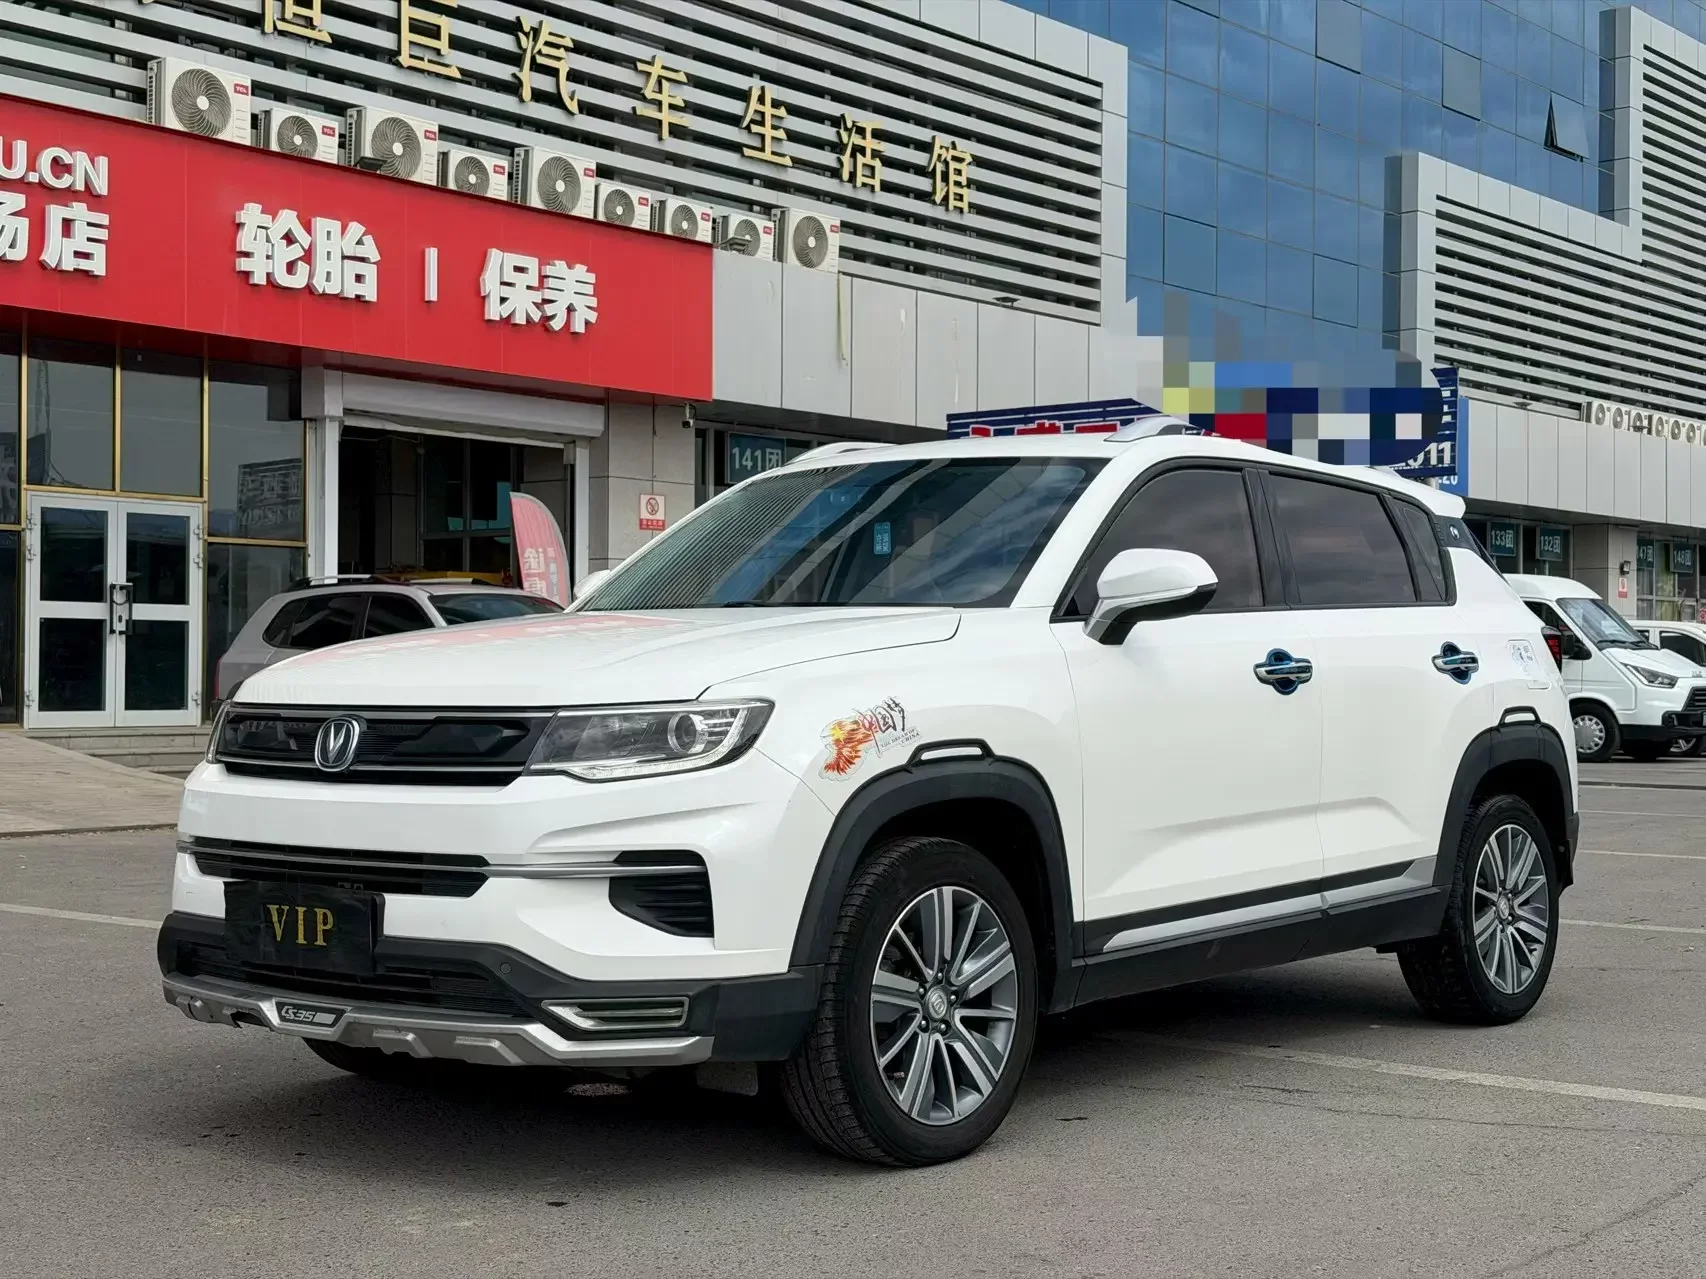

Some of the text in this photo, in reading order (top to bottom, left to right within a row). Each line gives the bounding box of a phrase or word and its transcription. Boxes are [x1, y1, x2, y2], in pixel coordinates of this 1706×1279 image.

[234, 84, 249, 95] TCL
[322, 126, 335, 137] TCL
[424, 130, 437, 140] TCL
[235, 201, 598, 333] 轮胎 保养
[266, 904, 334, 946] VIP
[280, 1005, 316, 1022] CS35
